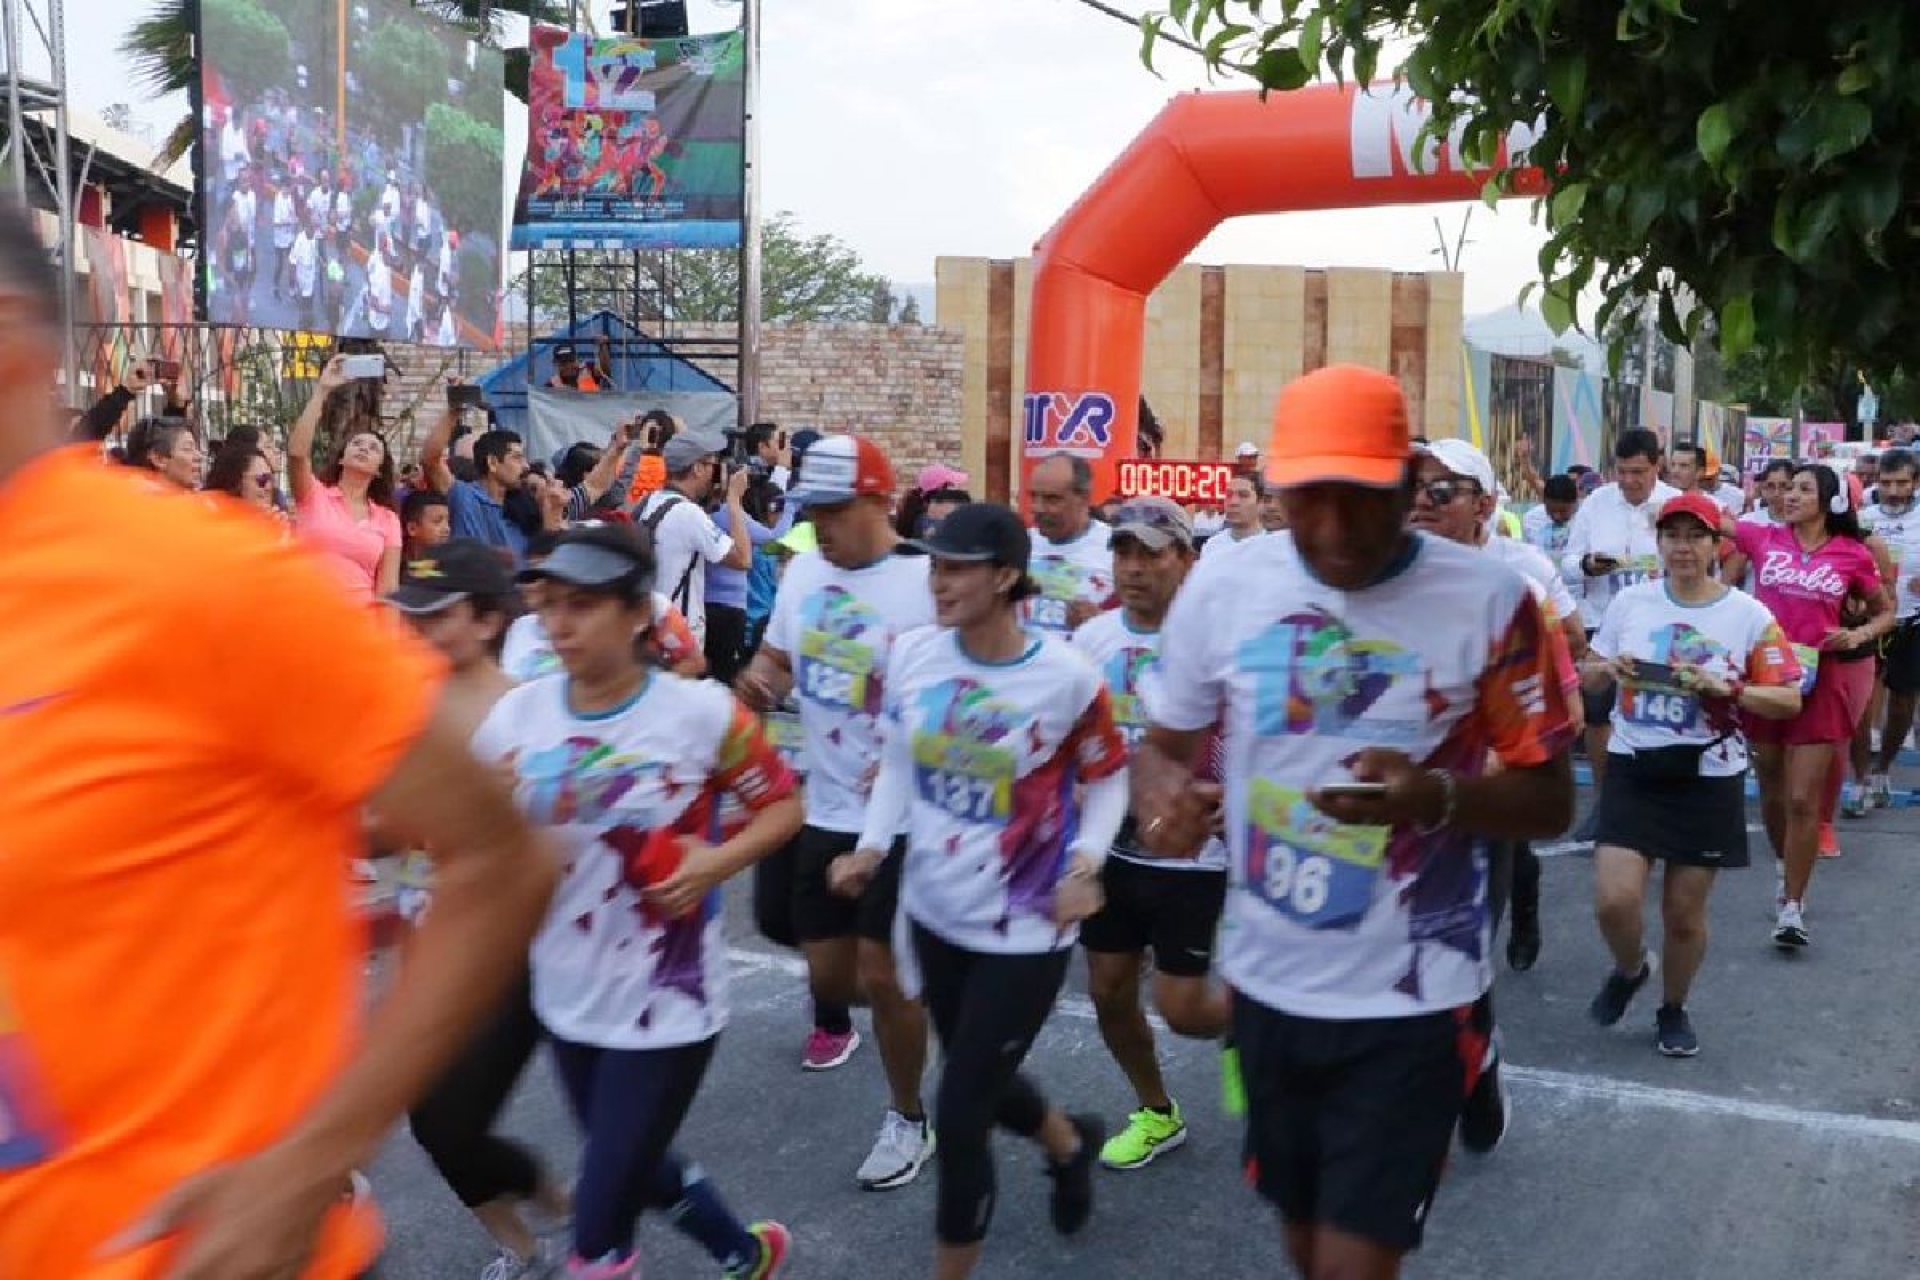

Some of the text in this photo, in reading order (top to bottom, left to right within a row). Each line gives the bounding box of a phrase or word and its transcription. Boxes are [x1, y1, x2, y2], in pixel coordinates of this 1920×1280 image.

[1024, 391, 1114, 445] TYR
[1120, 463, 1231, 499] 00:00:20
[1759, 551, 1844, 596] Barbie
[1632, 690, 1685, 723] 146
[927, 769, 997, 818] 137
